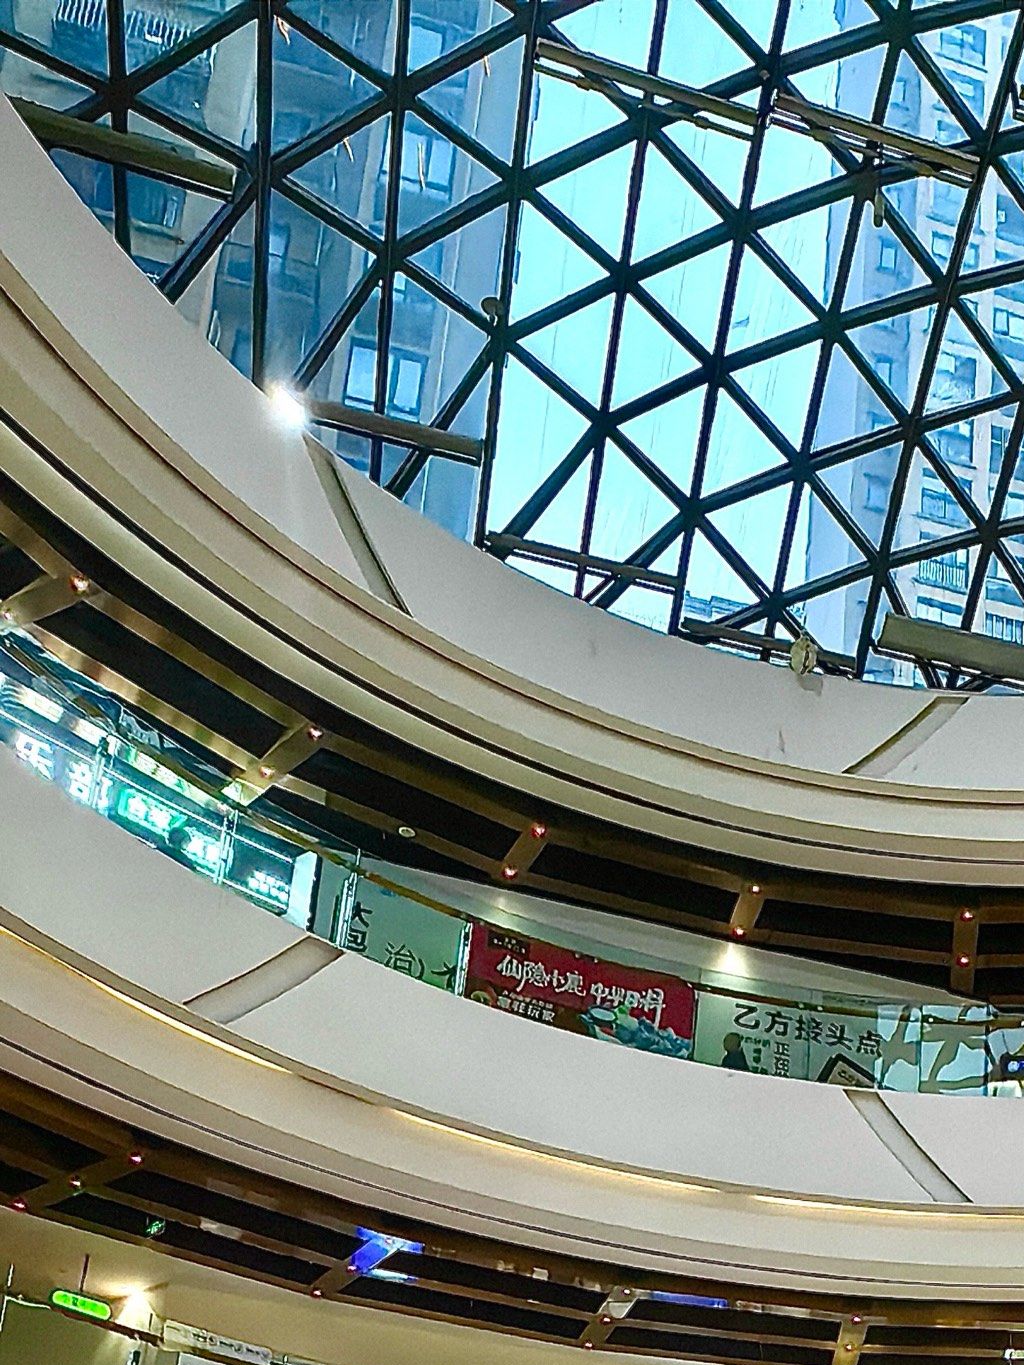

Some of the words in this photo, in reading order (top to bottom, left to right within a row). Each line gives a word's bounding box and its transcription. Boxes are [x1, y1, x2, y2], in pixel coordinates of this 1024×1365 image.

[733, 1002, 885, 1058] 乙方接头点
